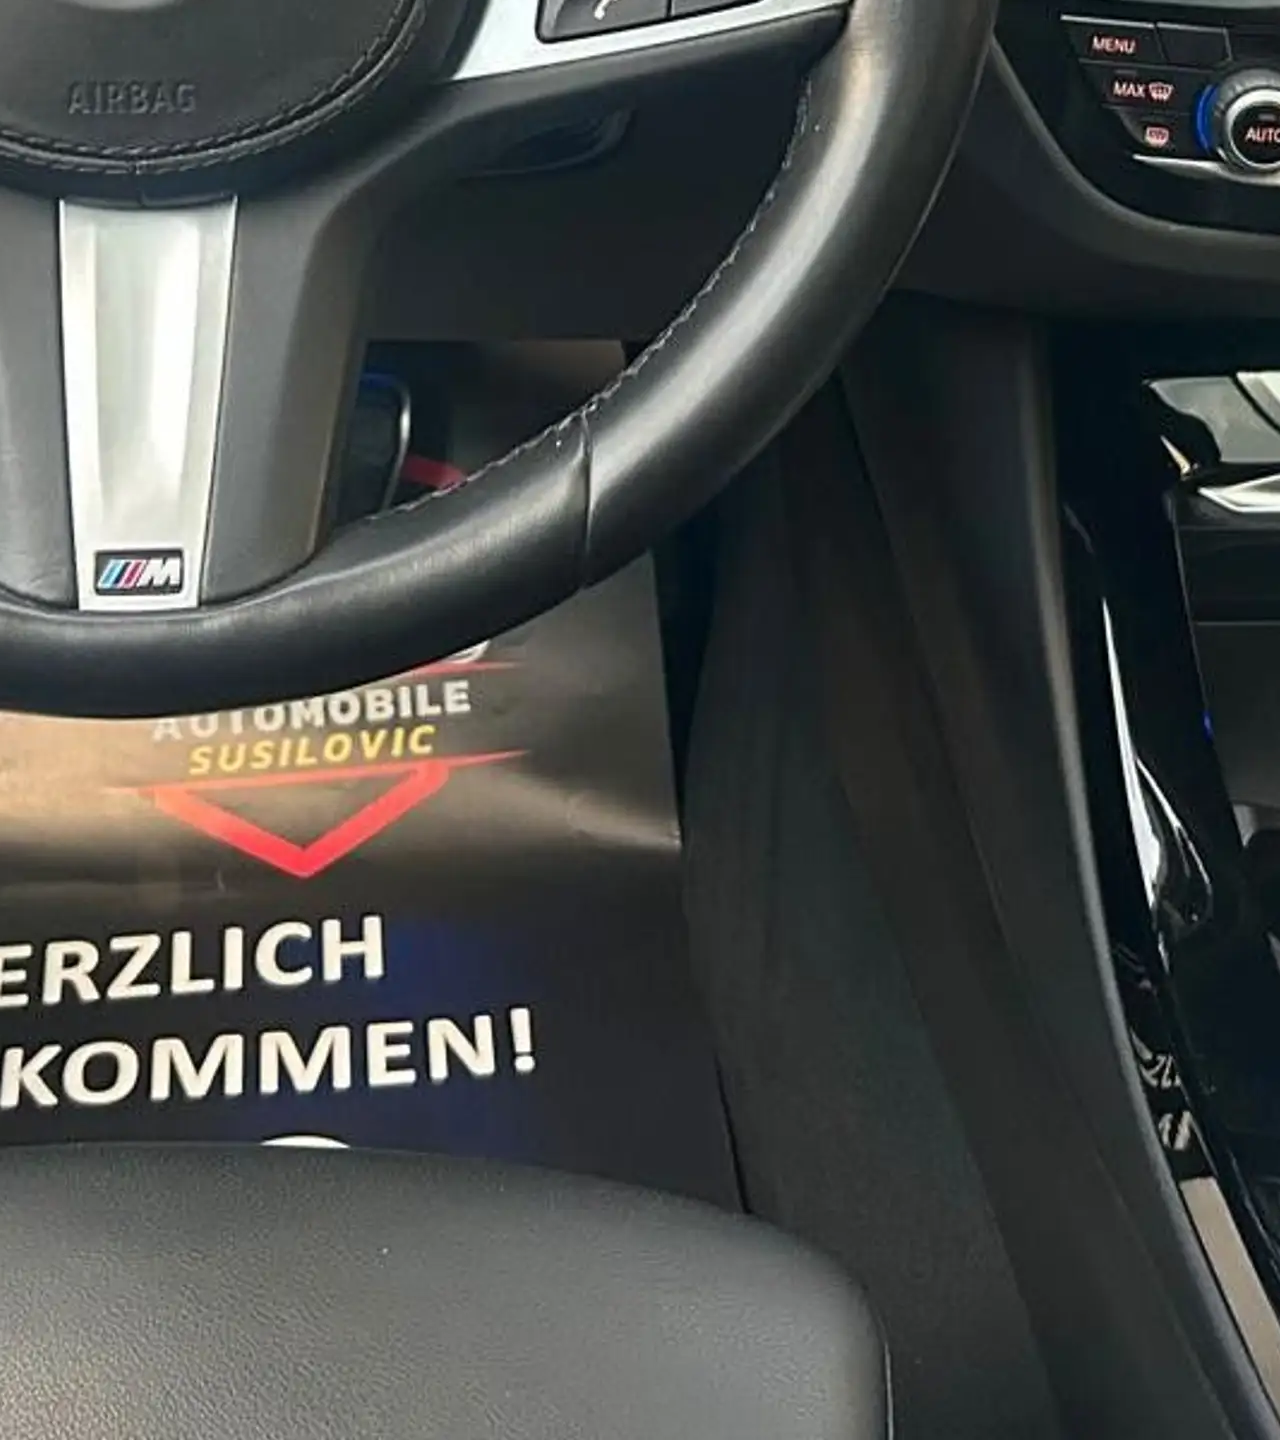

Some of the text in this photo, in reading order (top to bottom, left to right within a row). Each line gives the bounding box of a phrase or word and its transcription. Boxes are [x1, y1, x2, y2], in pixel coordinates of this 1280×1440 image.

[1091, 35, 1137, 54] MENU
[66, 81, 199, 118] AIRBAG
[1113, 81, 1147, 99] MAX
[151, 679, 472, 743] AUTOMOBILE
[188, 724, 437, 777] SUSILOVIC
